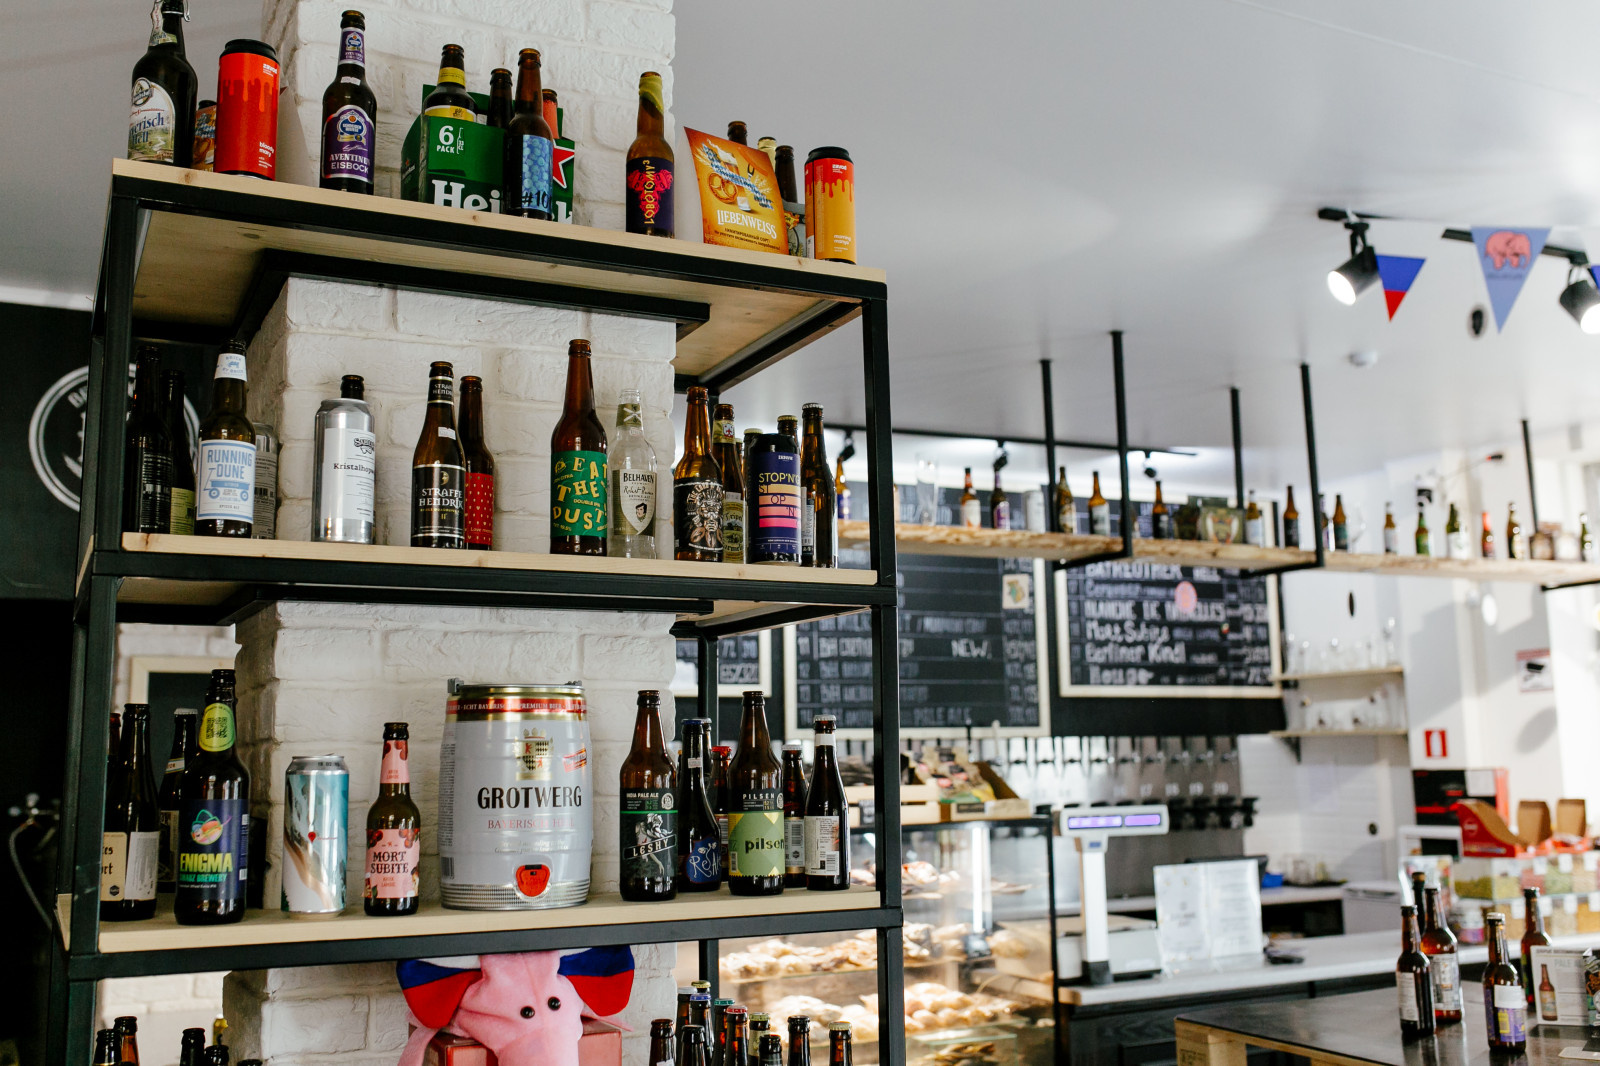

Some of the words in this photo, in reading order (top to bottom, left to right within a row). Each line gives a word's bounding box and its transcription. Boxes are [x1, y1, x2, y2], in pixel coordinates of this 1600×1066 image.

[438, 125, 455, 146] 6
[436, 145, 455, 154] PACK
[331, 162, 369, 174] EISBOCK
[716, 209, 778, 240] LIEBENWEISS
[207, 449, 253, 469] RUNNING
[216, 463, 245, 480] DUNE
[623, 472, 655, 484] BELHAVEN
[421, 487, 463, 499] STRAFFE
[770, 494, 787, 506] OP
[477, 786, 583, 809] GROTWERG
[742, 792, 775, 800] PILSEN
[180, 852, 233, 873] ENIGMA
[372, 851, 407, 863] MORT
[370, 863, 409, 875] SUBITE
